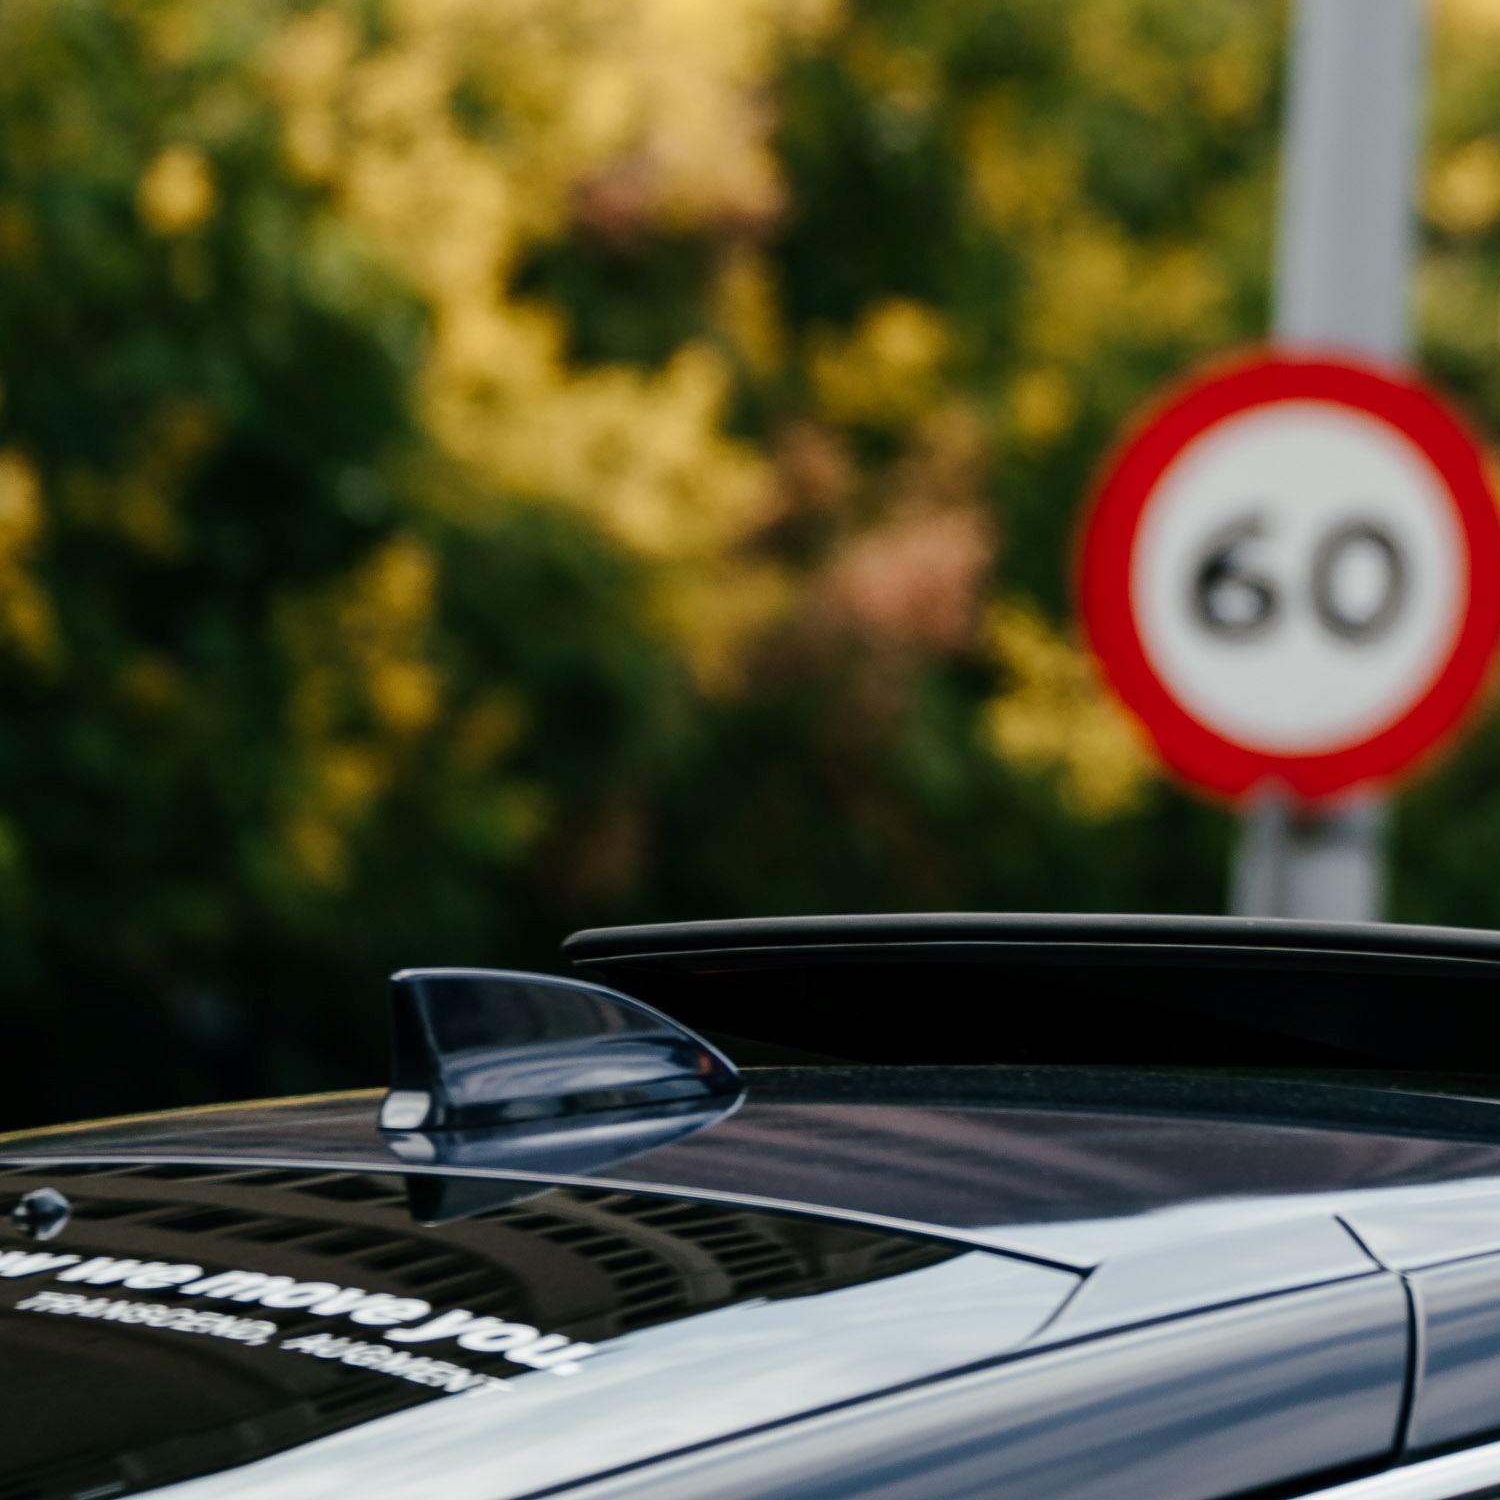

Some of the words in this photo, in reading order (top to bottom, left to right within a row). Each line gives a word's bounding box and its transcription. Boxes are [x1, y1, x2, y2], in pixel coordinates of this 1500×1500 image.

[1192, 514, 1408, 645] 60
[56, 1256, 204, 1290] we
[178, 1269, 432, 1327] move
